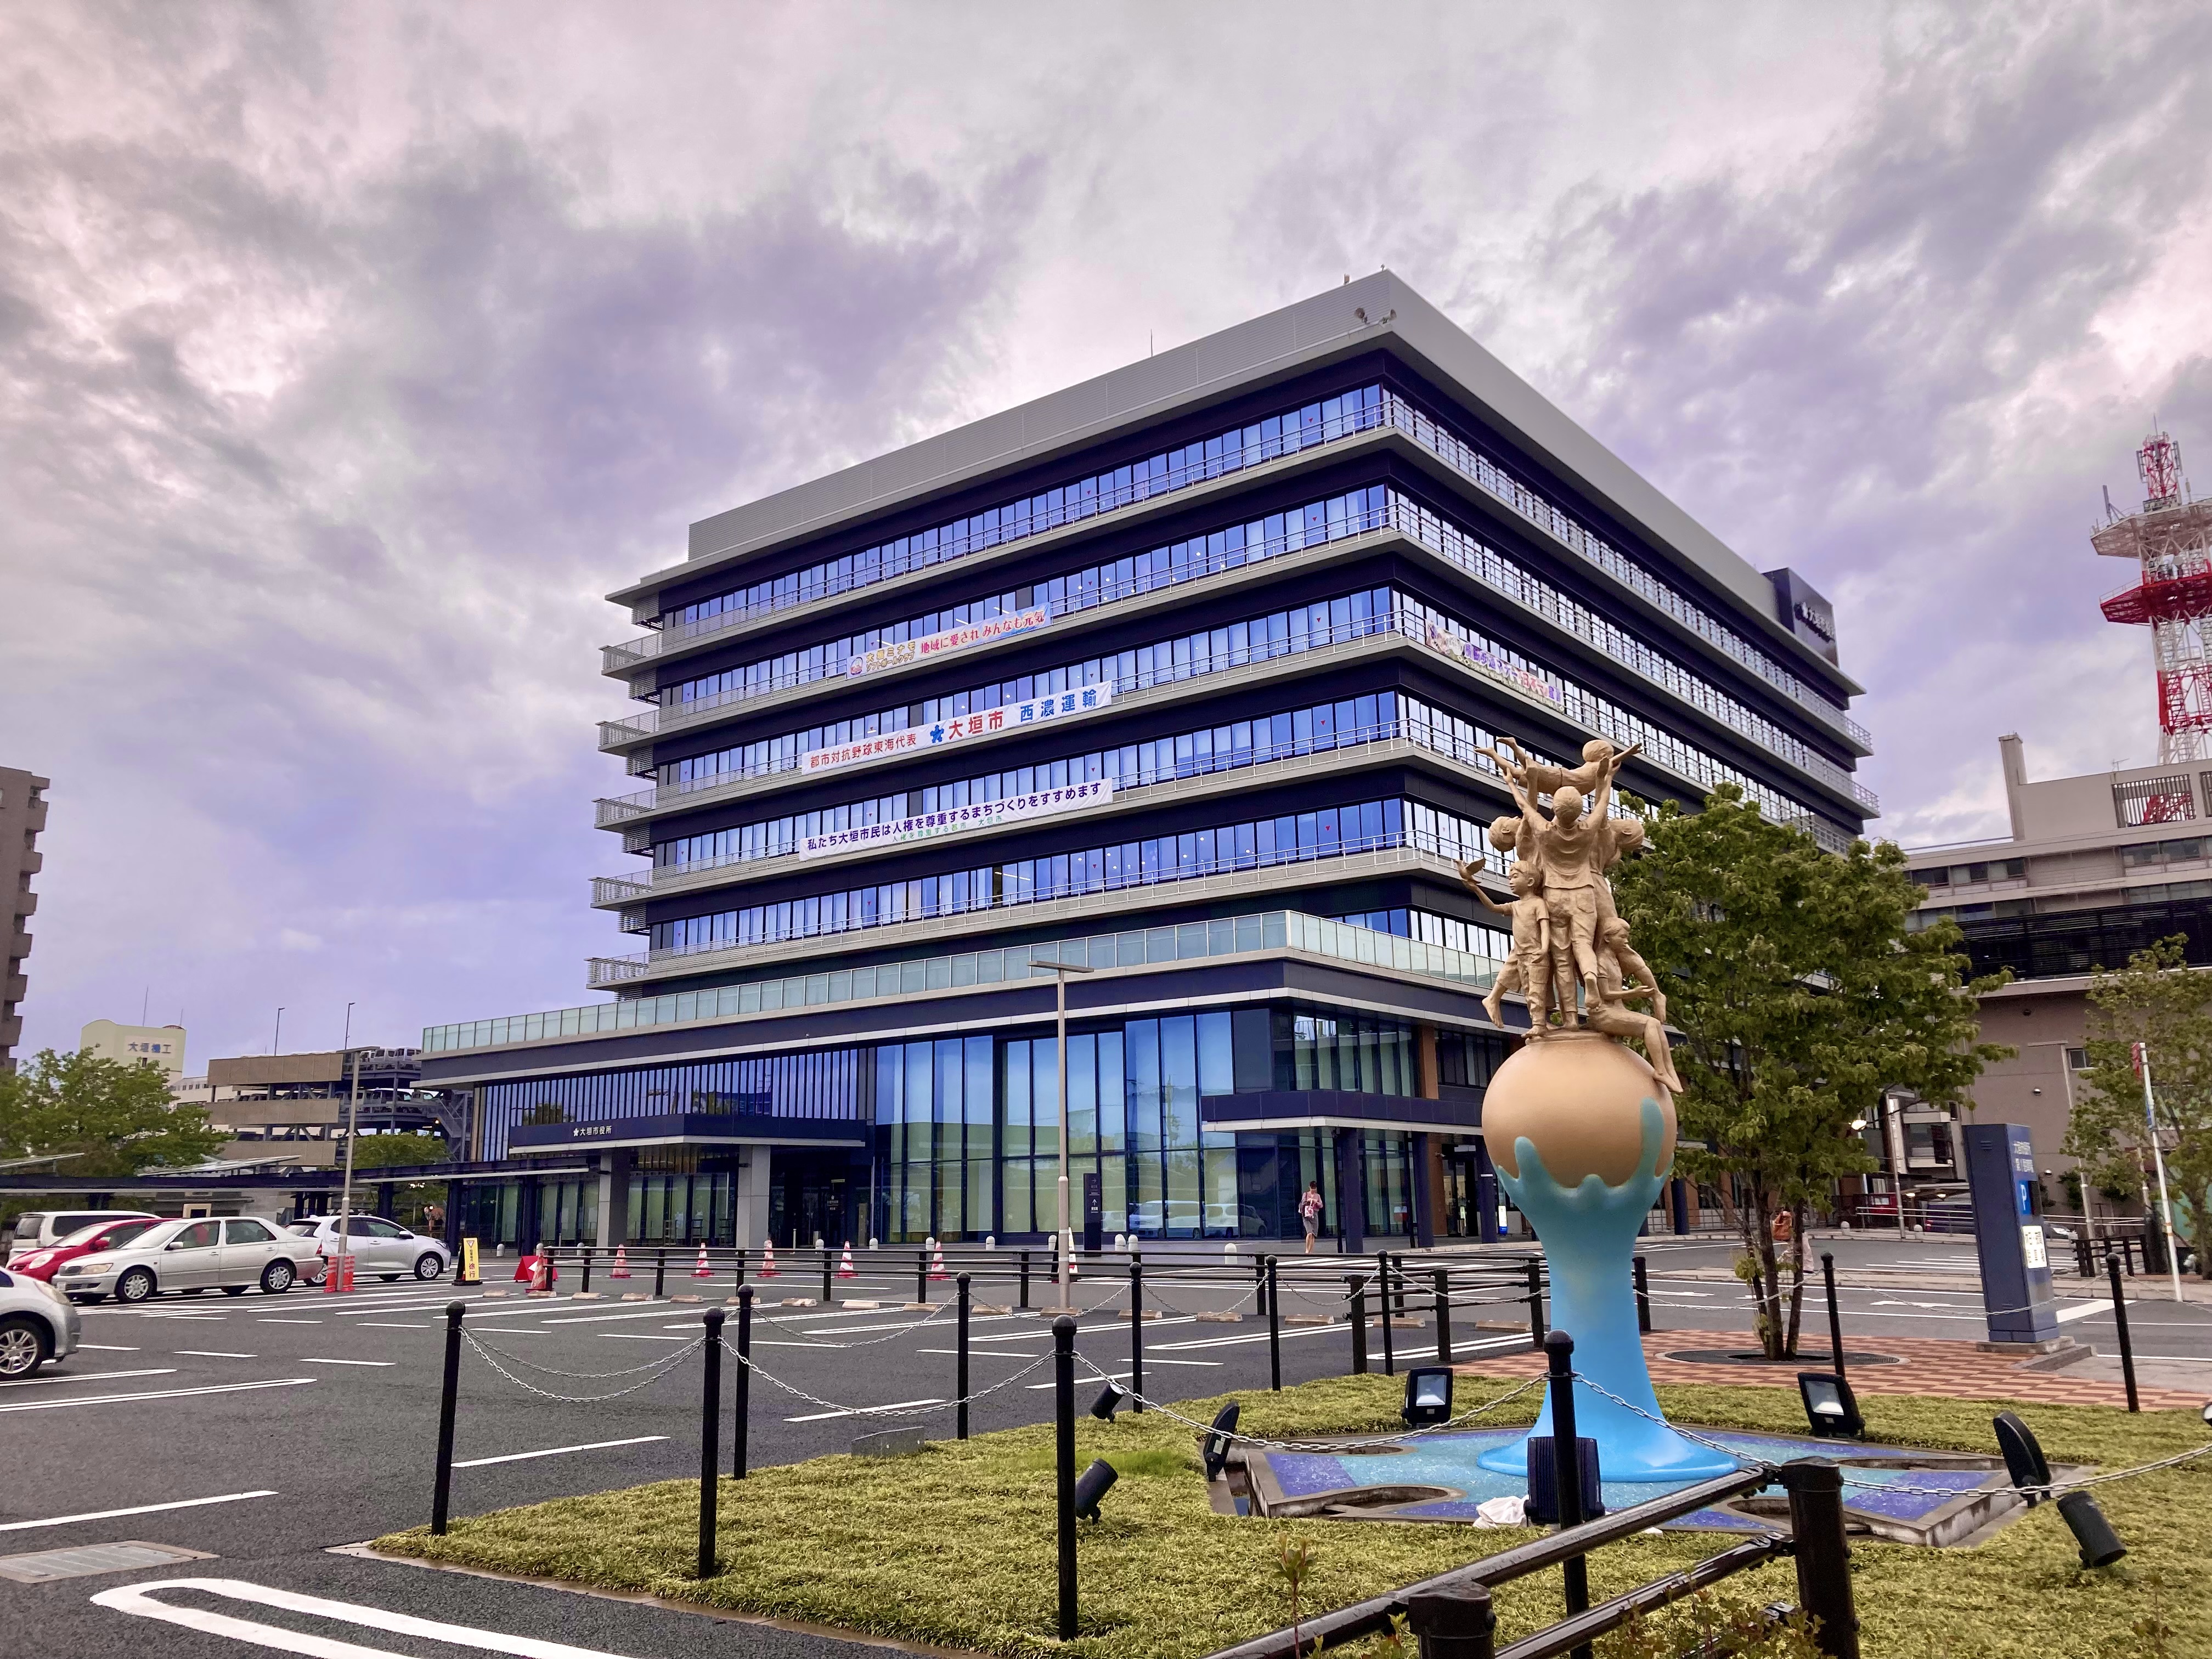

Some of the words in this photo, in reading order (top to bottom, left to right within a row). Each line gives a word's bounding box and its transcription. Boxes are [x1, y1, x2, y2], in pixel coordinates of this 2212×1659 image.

[921, 629, 979, 654] 地域に愛され
[982, 611, 1045, 637] みんなも元気
[866, 641, 916, 663] 大垣ミナモ
[866, 651, 915, 672] ソフトボールクラブ
[810, 733, 917, 769] 都市対抗野球東海代表
[949, 710, 1003, 740] 大垣市
[1020, 689, 1097, 723] 西濃運輸
[807, 782, 1101, 851] 私たち大垣市民は人権を尊重するまちづくりをすすめます
[891, 822, 967, 843] 人権を尊重する都市
[978, 815, 1002, 827] 大垣市
[579, 1125, 612, 1136] 大垣市役所
[2020, 1184, 2027, 1211] P
